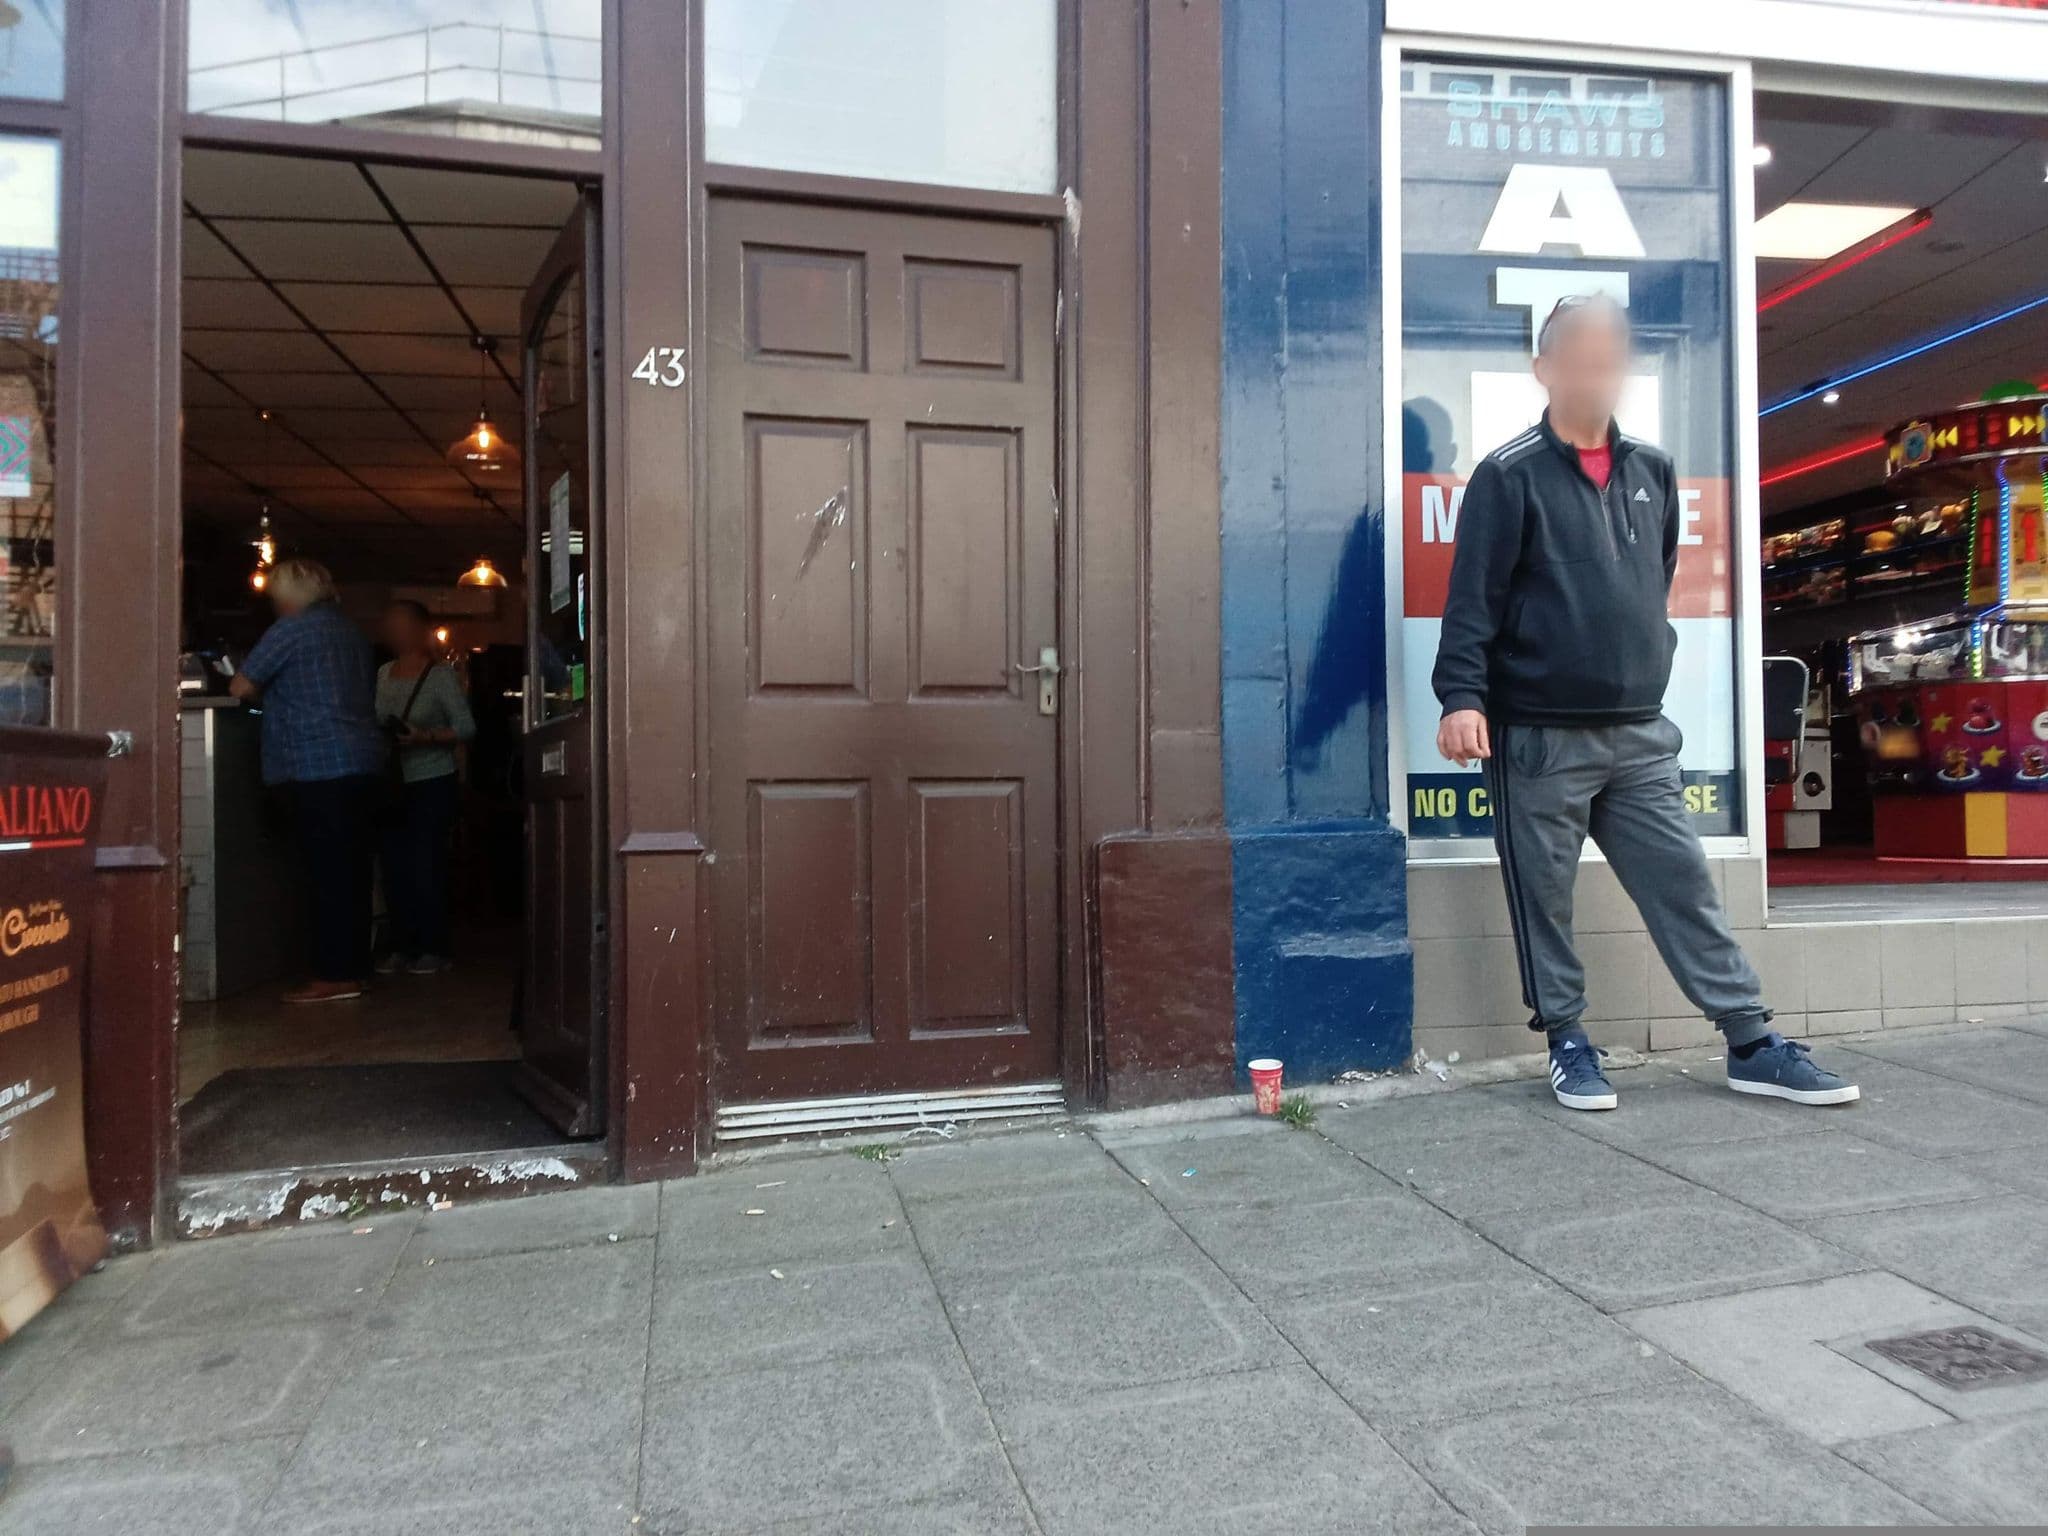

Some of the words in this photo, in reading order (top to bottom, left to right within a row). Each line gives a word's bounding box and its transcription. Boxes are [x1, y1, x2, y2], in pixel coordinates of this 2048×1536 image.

[1447, 80, 1664, 128] SHAWS
[1448, 119, 1665, 158] AMUSEMENTS
[631, 346, 685, 387] 43
[1414, 788, 1457, 818] NO
